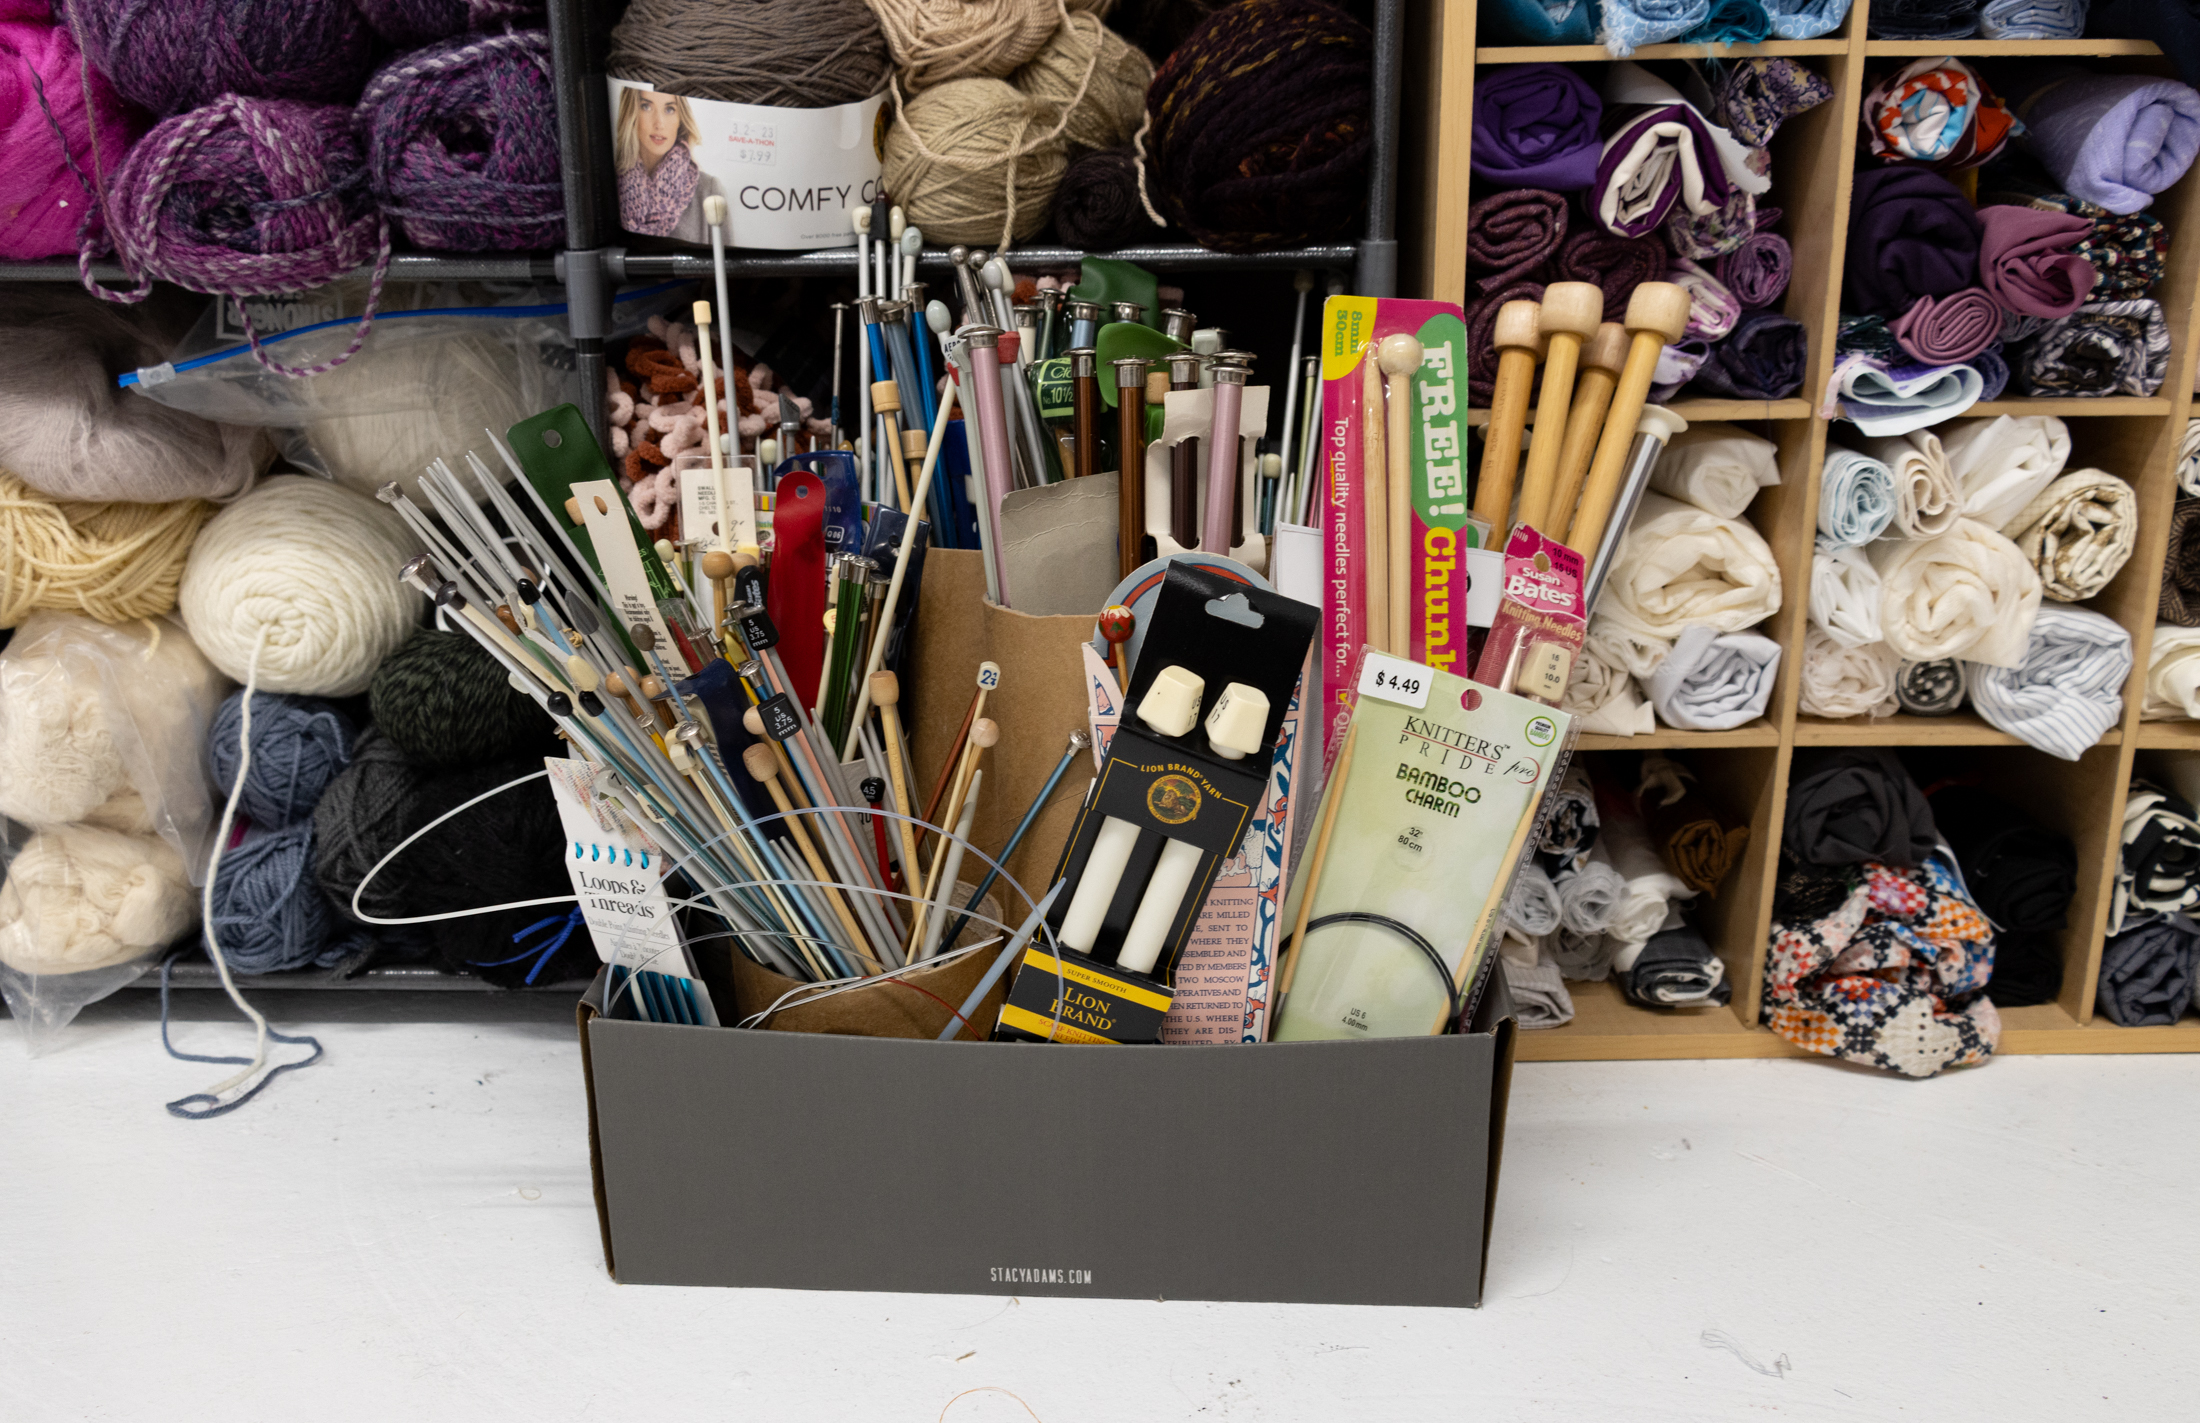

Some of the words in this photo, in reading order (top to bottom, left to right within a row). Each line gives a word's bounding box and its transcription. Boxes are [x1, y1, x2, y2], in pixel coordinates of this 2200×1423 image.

[728, 135, 775, 147] SAVE-A-THON
[740, 149, 771, 162] $7.99
[740, 184, 851, 212] COMFY
[1334, 309, 1348, 357] 30cm
[1350, 310, 1363, 355] 8mm
[1330, 417, 1349, 448] Top
[1420, 340, 1465, 517] FREE!
[1331, 451, 1350, 509] quality
[1335, 513, 1351, 575] needles
[1553, 547, 1562, 558] 10
[1563, 553, 1579, 566] mm
[1522, 566, 1561, 586] Susan
[1554, 561, 1564, 572] 15
[1565, 566, 1578, 579] US
[1507, 574, 1573, 607] Bates
[1331, 579, 1351, 639] perfect
[748, 618, 755, 626] 5
[749, 625, 760, 634] US
[1502, 600, 1544, 629] Knitting
[1542, 615, 1582, 642] Needles
[749, 630, 766, 641] 3.75
[752, 638, 769, 648] mm
[1335, 641, 1351, 678] for...
[1375, 670, 1386, 688] $
[1388, 675, 1420, 695] 4.49
[1544, 672, 1560, 684] 10.0
[773, 706, 781, 714] 5
[1220, 692, 1230, 711] US
[774, 712, 787, 722] US
[774, 716, 793, 730] 3.75
[1211, 708, 1221, 724] 17
[778, 723, 797, 737] mm
[1404, 715, 1503, 761] KNITTER'S
[1398, 734, 1496, 775] PRIDE
[1503, 760, 1536, 777] pro
[1140, 764, 1164, 773] LION
[1167, 763, 1201, 779] BRAND
[1200, 778, 1223, 799] YARN
[1395, 762, 1482, 804] BAMBOO
[1405, 788, 1461, 818] CHARM
[1398, 834, 1409, 846] 80
[1409, 840, 1423, 852] cm
[578, 870, 630, 895] Loops
[630, 879, 646, 895] &
[1209, 898, 1254, 907] KNITTING
[1216, 911, 1251, 919] MILLED
[1208, 924, 1231, 932] SENT
[1235, 924, 1248, 932] TO
[1190, 937, 1222, 945] WHERE
[1225, 937, 1250, 945] THEY
[1195, 963, 1207, 971] BY
[1207, 962, 1247, 971] MEMBERS
[1066, 968, 1091, 982] SUPER
[1091, 977, 1128, 994] SMOOTH
[1178, 976, 1199, 984] TWO
[1203, 976, 1245, 984] MOSCOW
[1063, 986, 1112, 1015] LION
[1186, 1002, 1231, 1010] RETURNED
[1049, 998, 1112, 1031] BRAND
[1165, 1015, 1183, 1023] THE
[1186, 1015, 1202, 1023] U.S.
[1350, 1007, 1361, 1017] US
[1361, 1011, 1367, 1020] 6
[1194, 1027, 1213, 1035] ARE
[1341, 1016, 1356, 1027] 4.00
[1355, 1021, 1369, 1032] mm
[990, 1267, 1092, 1285] STACYADAMS.COM
